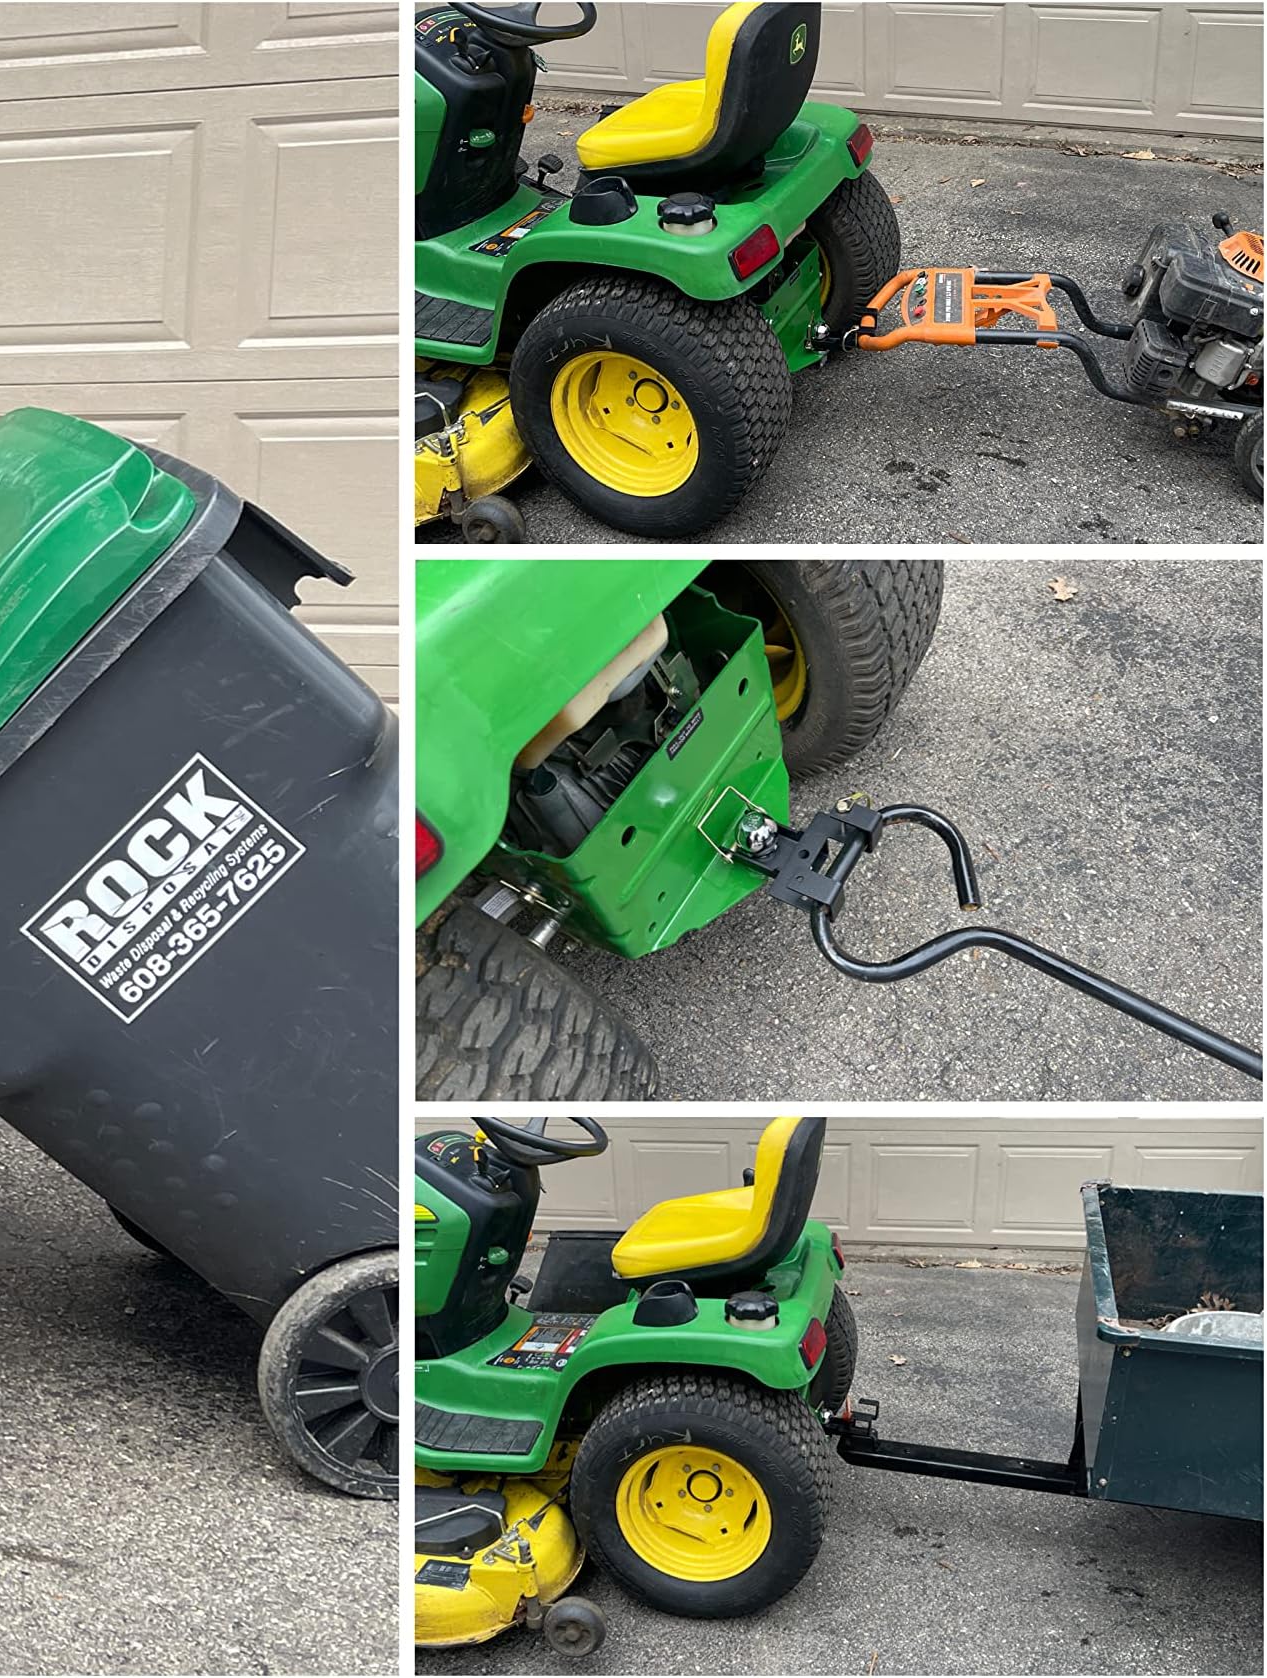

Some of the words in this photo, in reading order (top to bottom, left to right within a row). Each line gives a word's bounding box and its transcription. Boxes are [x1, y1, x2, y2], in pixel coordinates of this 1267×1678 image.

[39, 768, 240, 963] ROCK
[87, 823, 237, 969] DISPOSAL
[98, 957, 133, 989] Waste
[129, 914, 174, 962] Disposal
[169, 907, 184, 922] &
[178, 863, 230, 914] Recycling
[224, 823, 269, 867] Systems
[118, 837, 287, 1004] 608-365-7625
